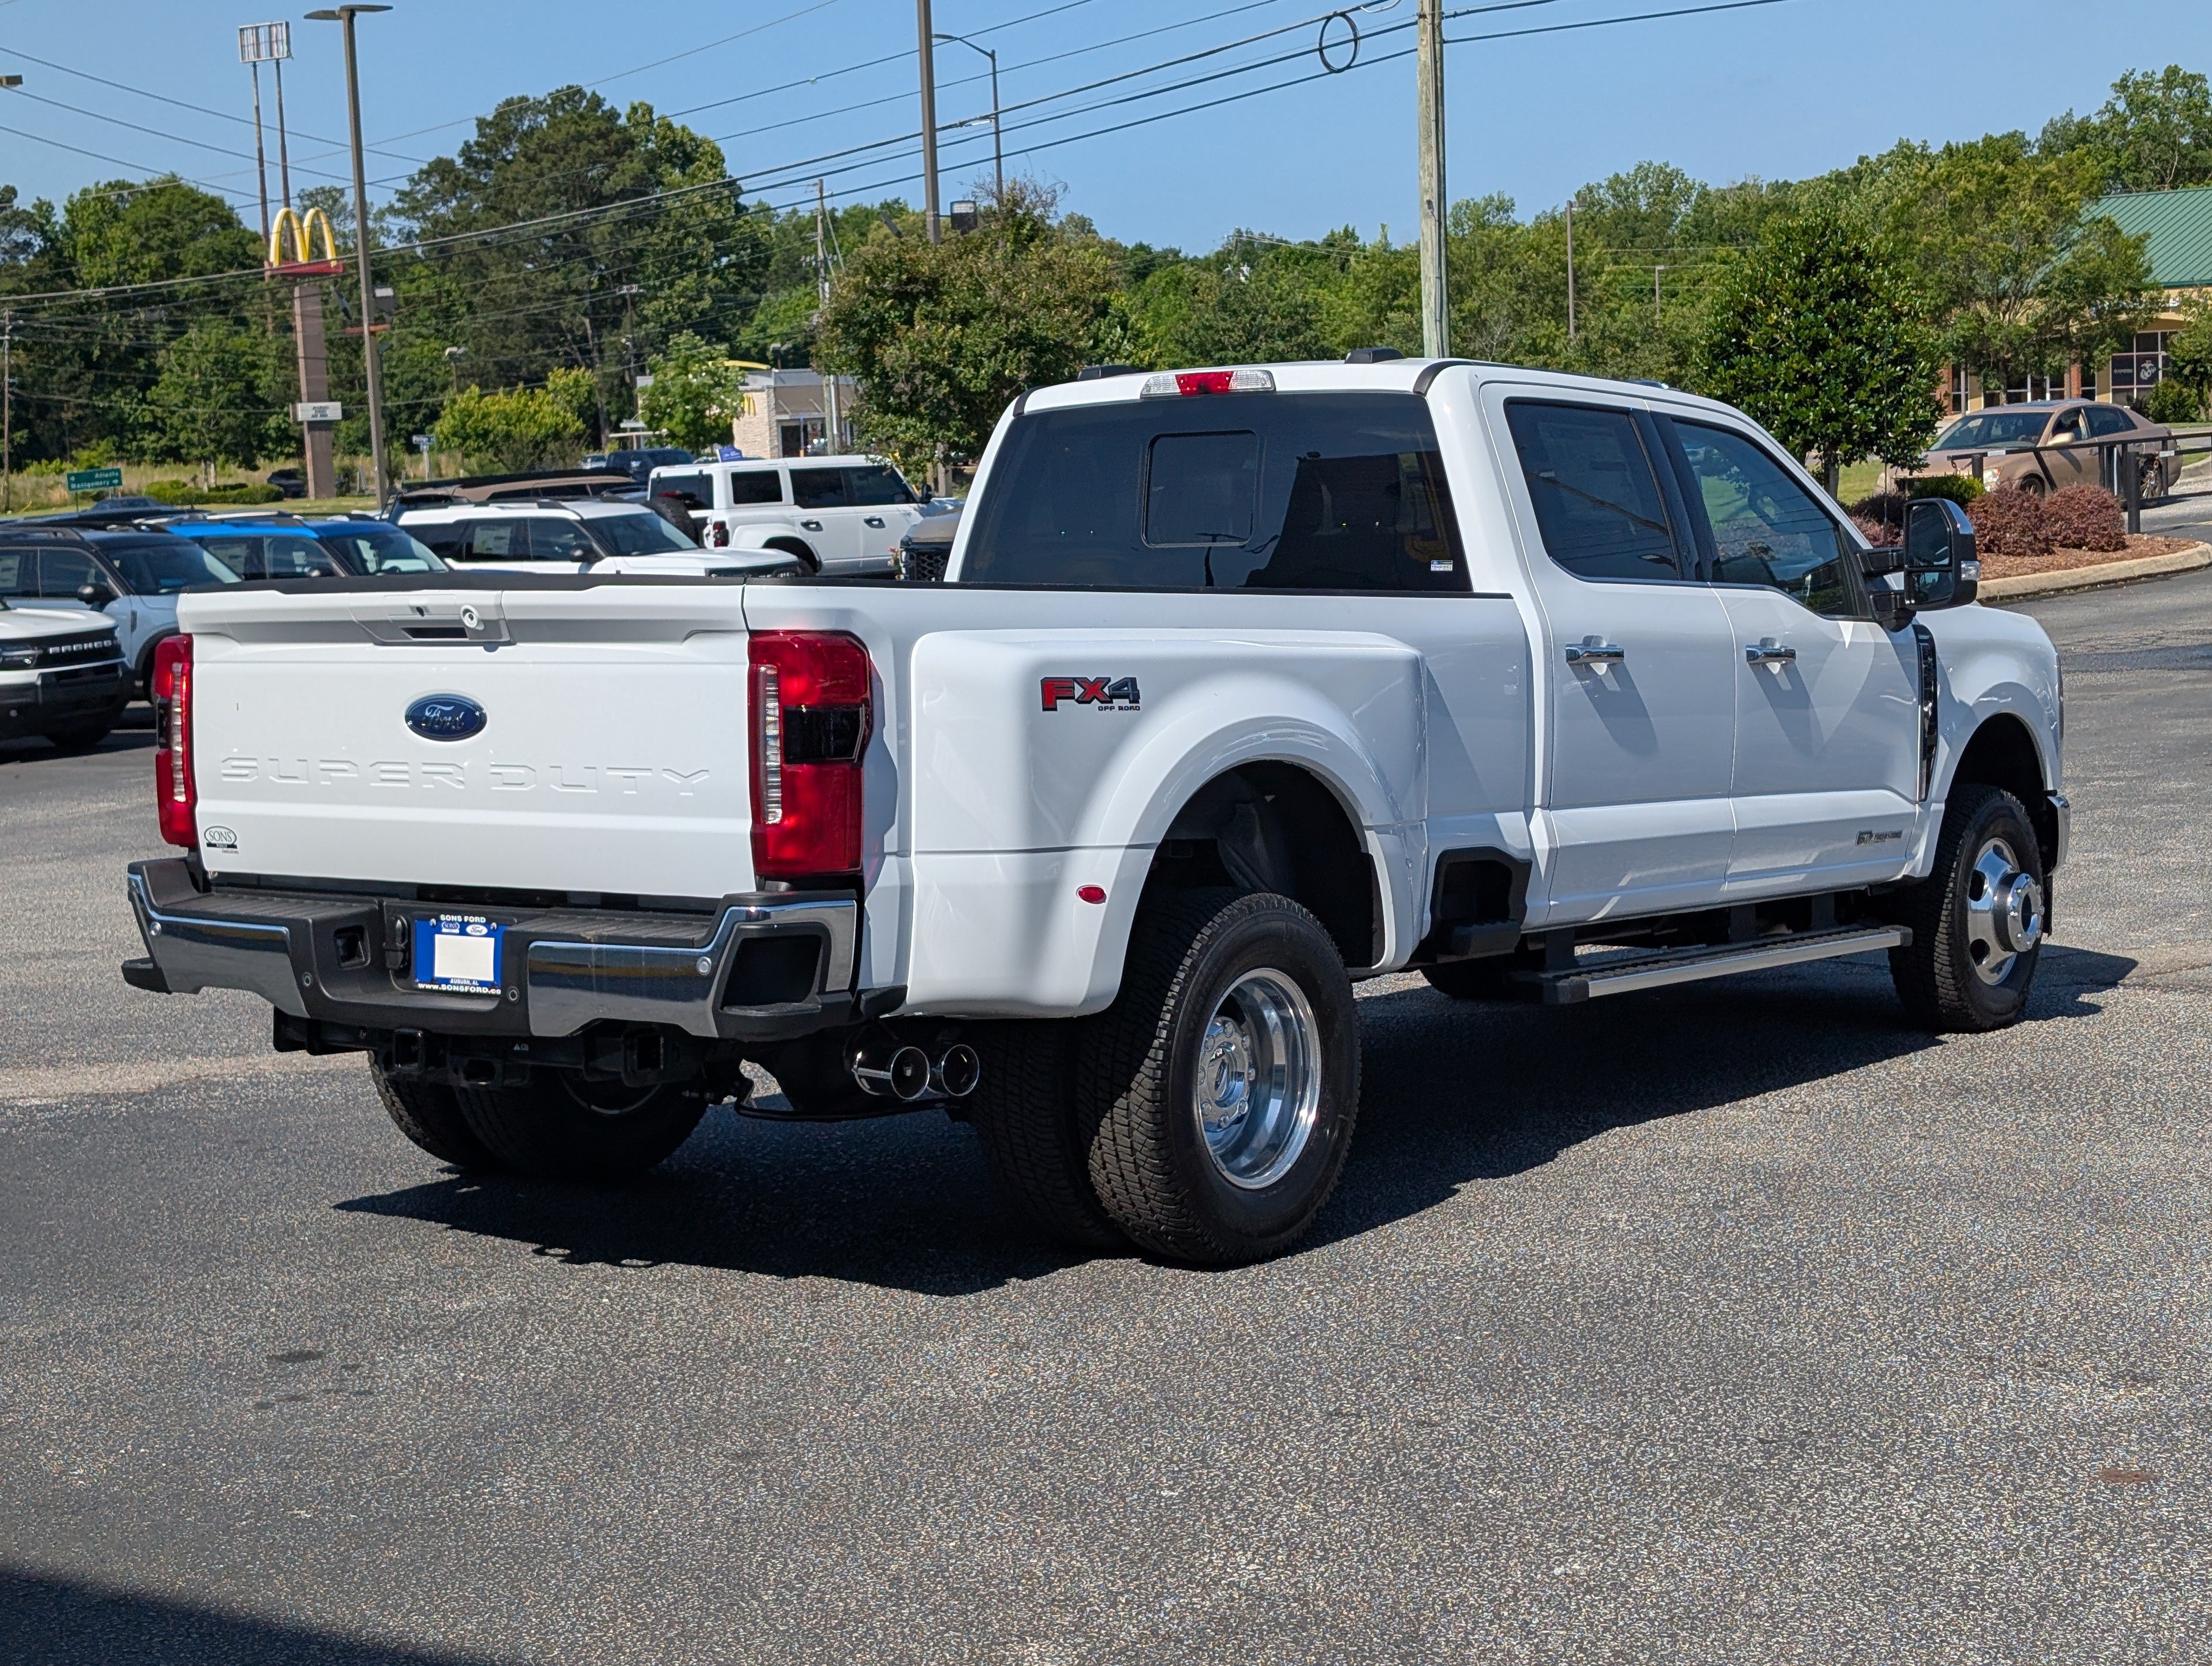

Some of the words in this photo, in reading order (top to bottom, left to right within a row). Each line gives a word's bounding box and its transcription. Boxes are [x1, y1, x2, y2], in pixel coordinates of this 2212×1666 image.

[49, 639, 112, 654] BRONCO
[1040, 676, 1141, 712] FX4
[422, 704, 466, 730] Ford
[221, 757, 465, 789] SUPER
[490, 763, 710, 796] DUTY
[209, 830, 233, 842] SONS
[440, 914, 462, 922] SONS
[470, 925, 484, 934] Ford
